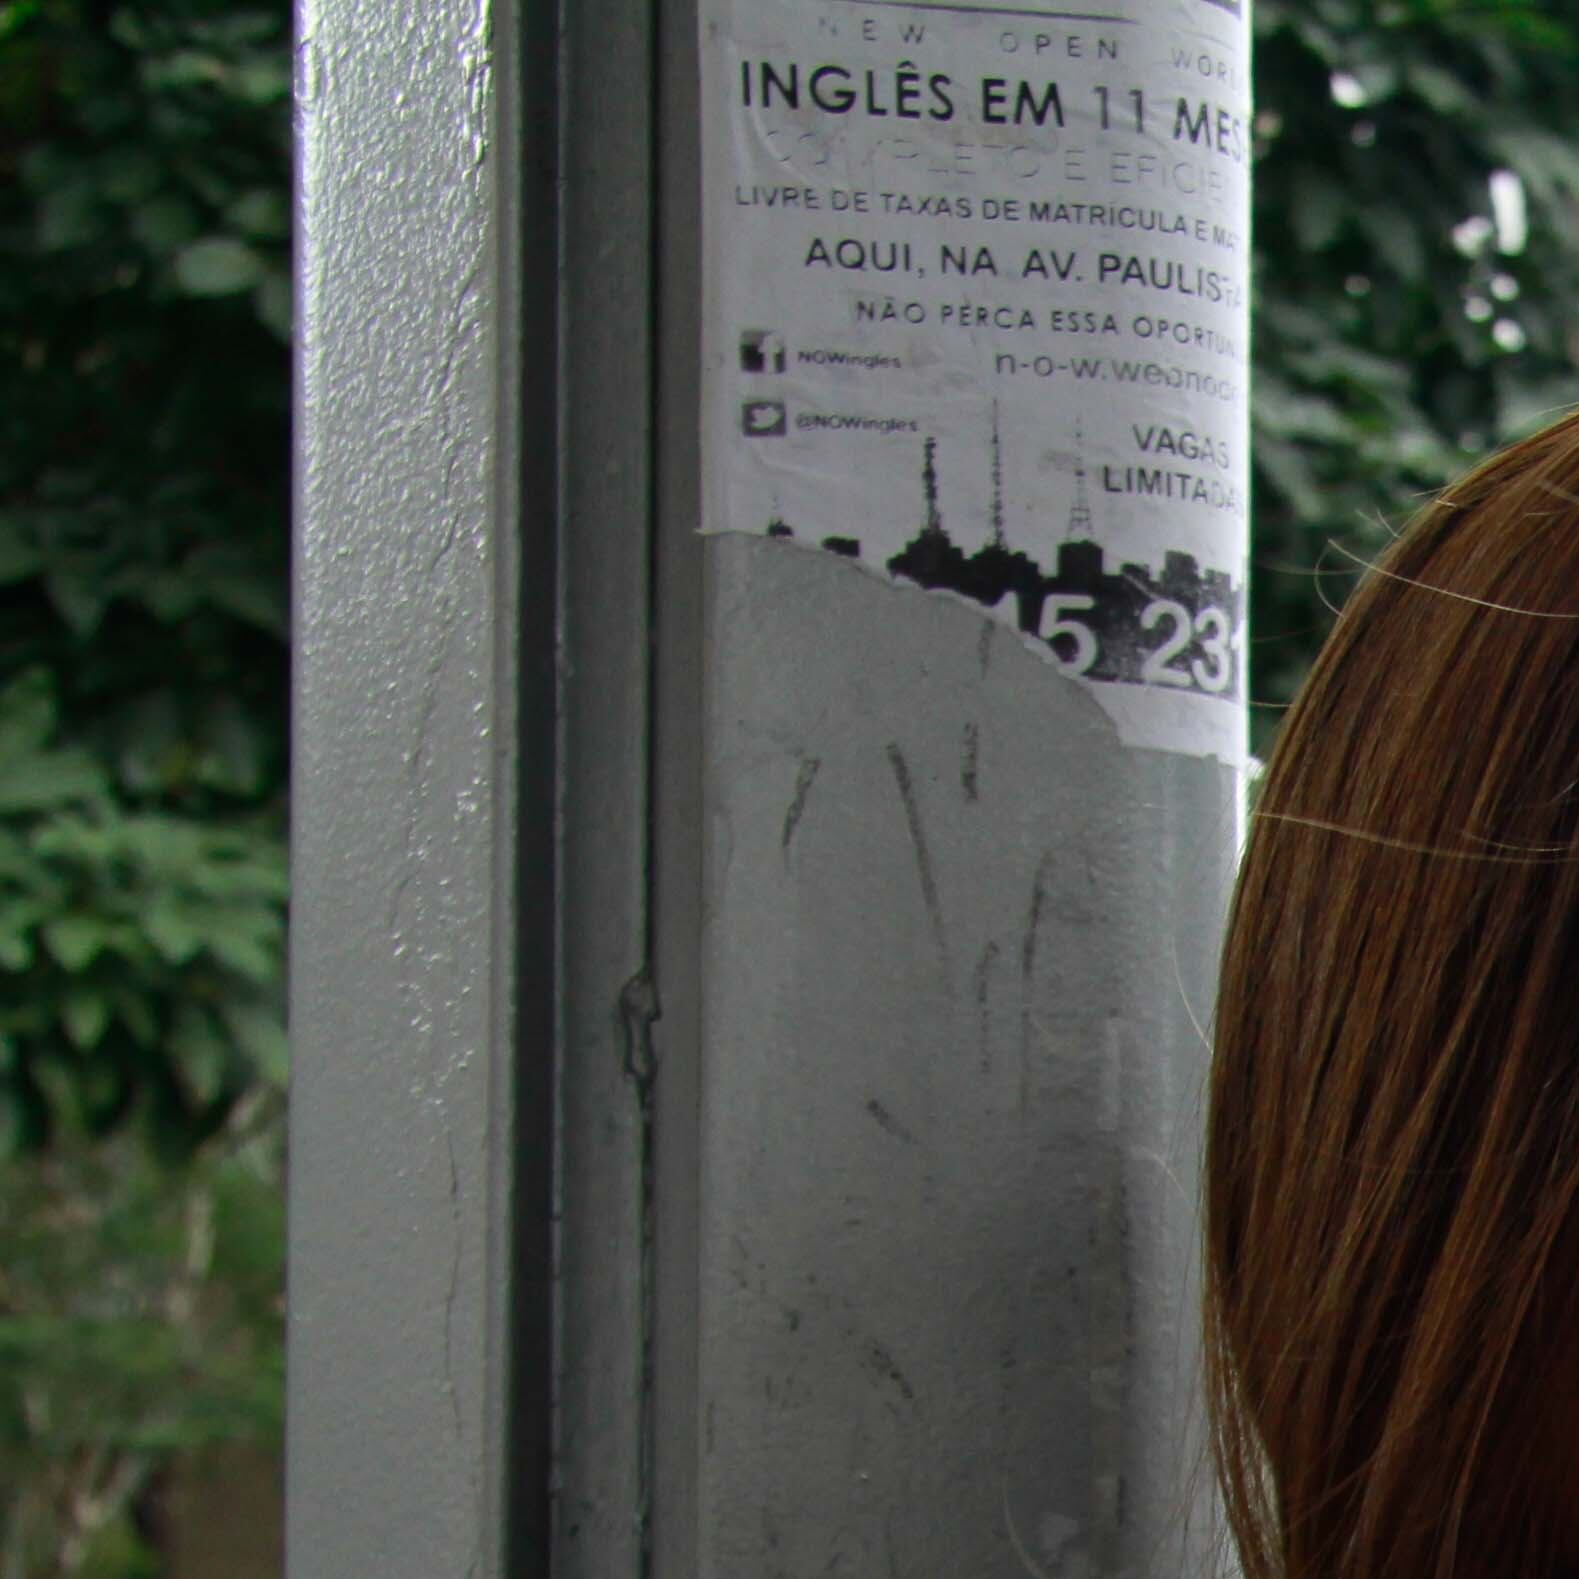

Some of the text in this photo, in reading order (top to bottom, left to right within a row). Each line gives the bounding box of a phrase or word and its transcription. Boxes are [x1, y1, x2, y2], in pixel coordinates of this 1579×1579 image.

[999, 31, 1120, 61] OPEN
[740, 59, 957, 122] INGLÊS
[981, 76, 1066, 128] EM
[1090, 85, 1146, 135] 11
[735, 184, 823, 210] LIVRE
[831, 188, 871, 213] DE
[879, 192, 974, 220] TAXAS
[982, 198, 1021, 222] DE
[1195, 218, 1209, 243] E
[804, 237, 927, 279] AQUI,
[940, 244, 998, 277] NA
[1021, 249, 1084, 282] AV.
[856, 296, 927, 325] NÃO
[941, 304, 1035, 330] PERCA
[1050, 309, 1120, 336] ESSA
[1131, 423, 1230, 470] VAGAS
[1138, 598, 1241, 693] 23
